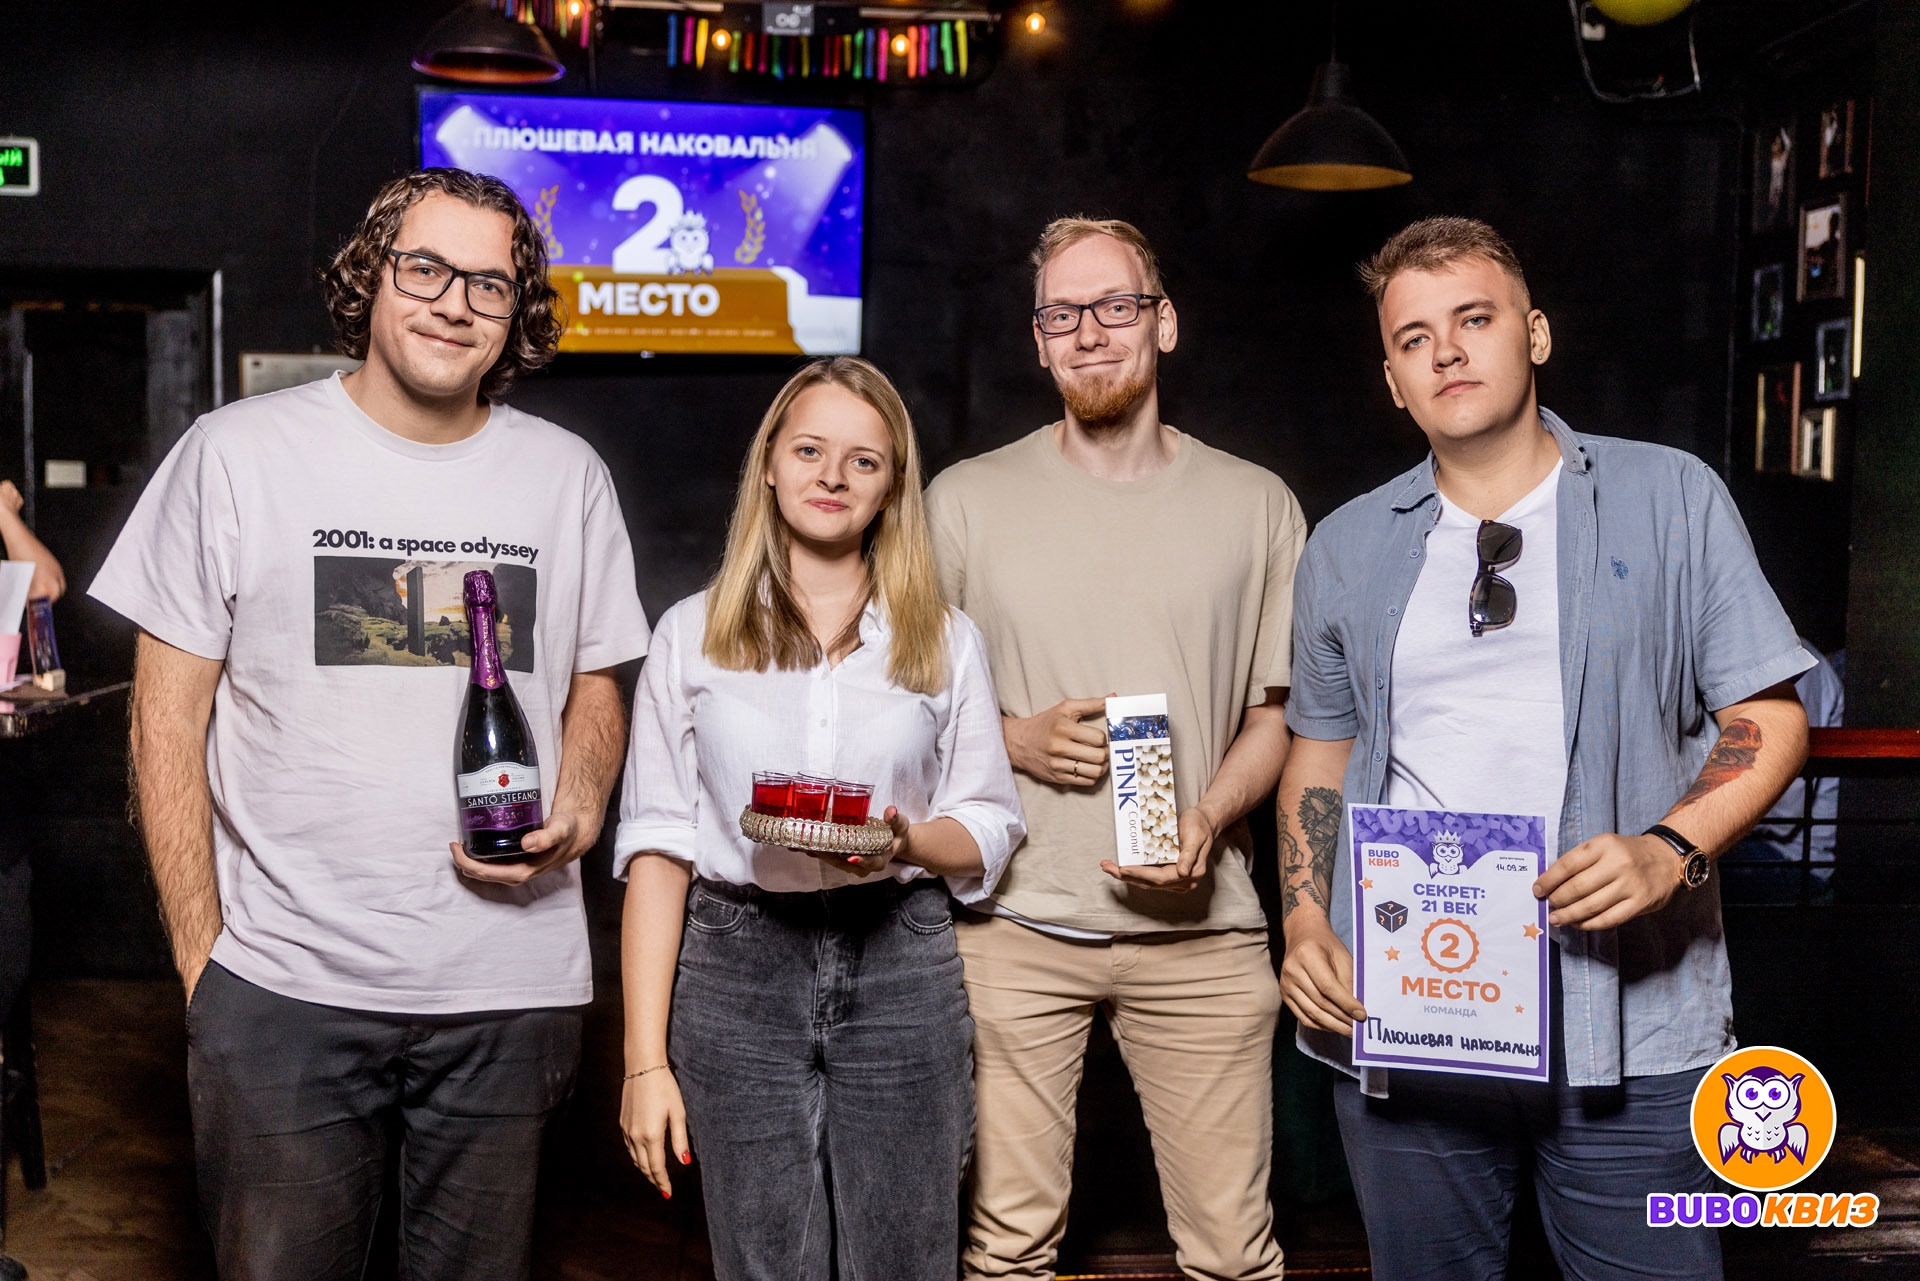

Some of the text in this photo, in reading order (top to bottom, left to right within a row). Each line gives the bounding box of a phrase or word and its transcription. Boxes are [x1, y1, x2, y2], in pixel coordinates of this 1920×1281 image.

[473, 126, 818, 160] ПЛЮШЕВАЯ НАКОВАЛЬНЯ
[612, 175, 684, 274] 2
[578, 281, 721, 317] МЕСТО
[312, 529, 539, 564] 2001: a space odyssey
[1114, 746, 1139, 811] PINK
[467, 790, 538, 807] SANTO STEFANO
[1127, 811, 1141, 855] Coconut
[1368, 849, 1399, 858] BUBO
[1368, 858, 1400, 868] КВИЗ
[1412, 883, 1486, 899] СЕКРЕТ:
[1421, 900, 1478, 915] 21 ВЕК
[1439, 932, 1460, 959] 2
[1401, 976, 1501, 1003] МЕСТО
[1423, 1004, 1478, 1018] КОМАНДА
